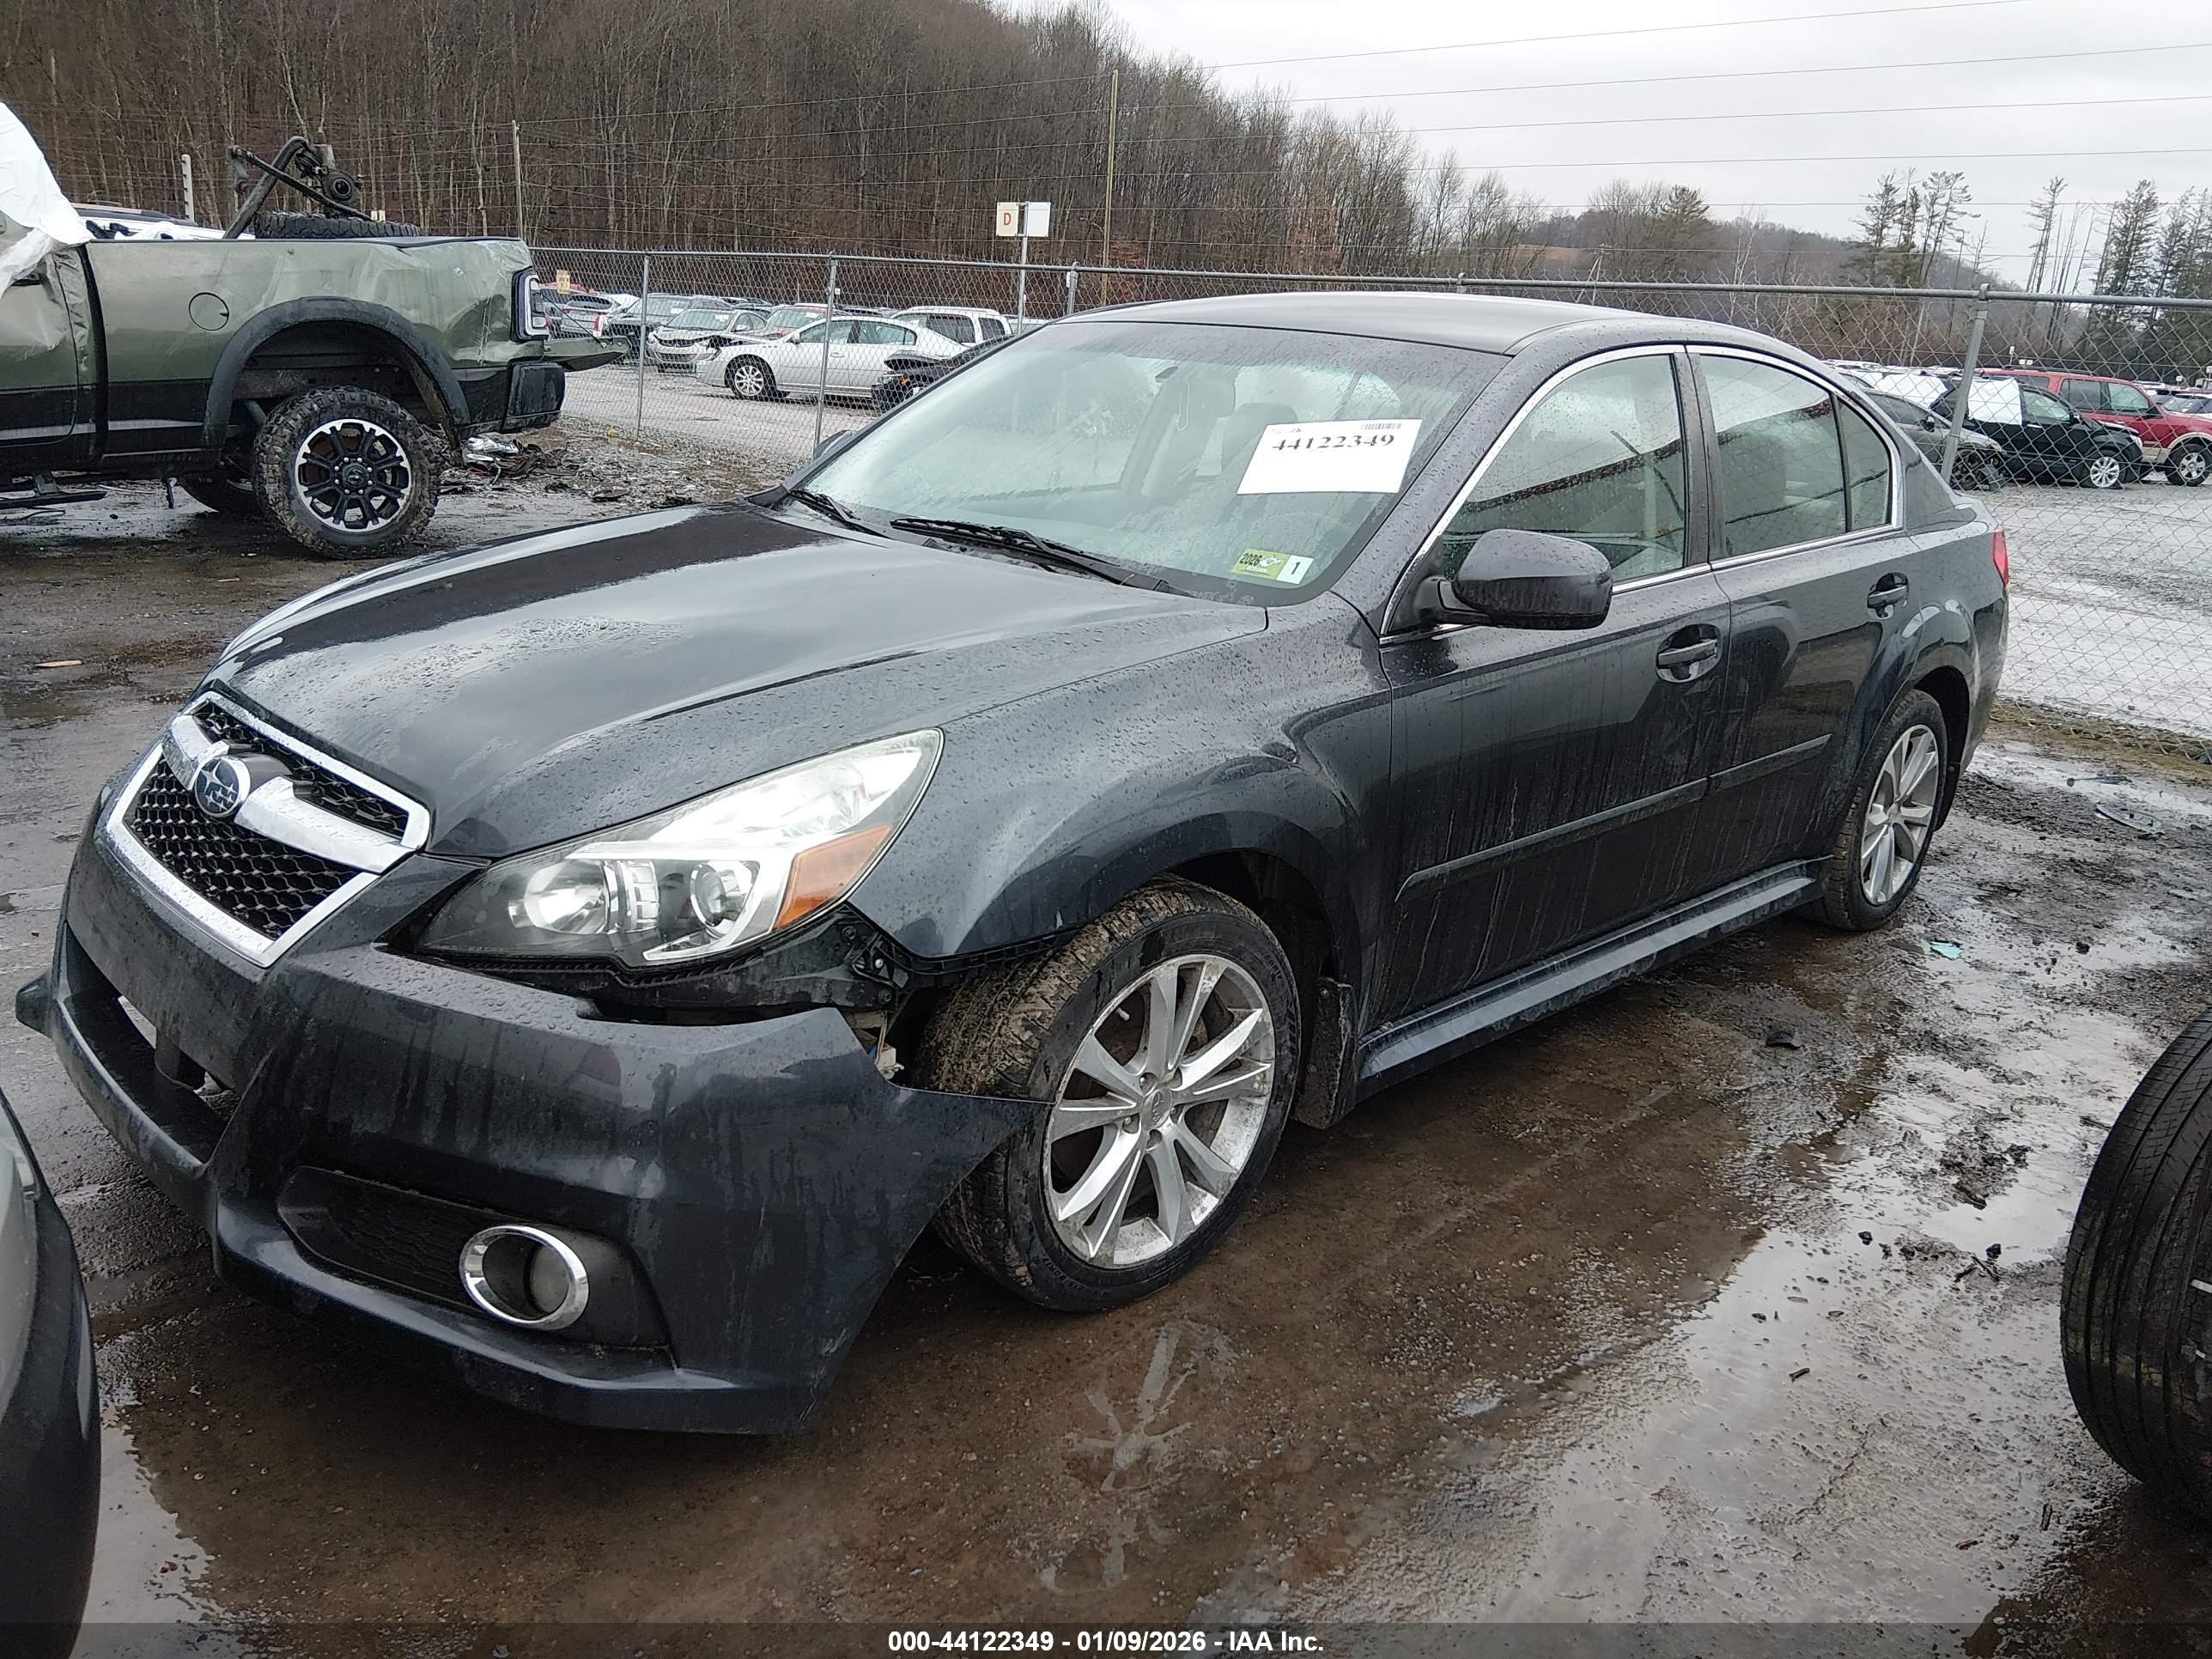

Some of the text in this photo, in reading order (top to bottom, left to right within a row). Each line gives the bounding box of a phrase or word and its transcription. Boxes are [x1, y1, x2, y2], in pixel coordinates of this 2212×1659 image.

[1003, 212, 1012, 226] D
[1272, 434, 1395, 451] 44122349
[1239, 552, 1263, 567] 2026
[1291, 561, 1302, 575] 1
